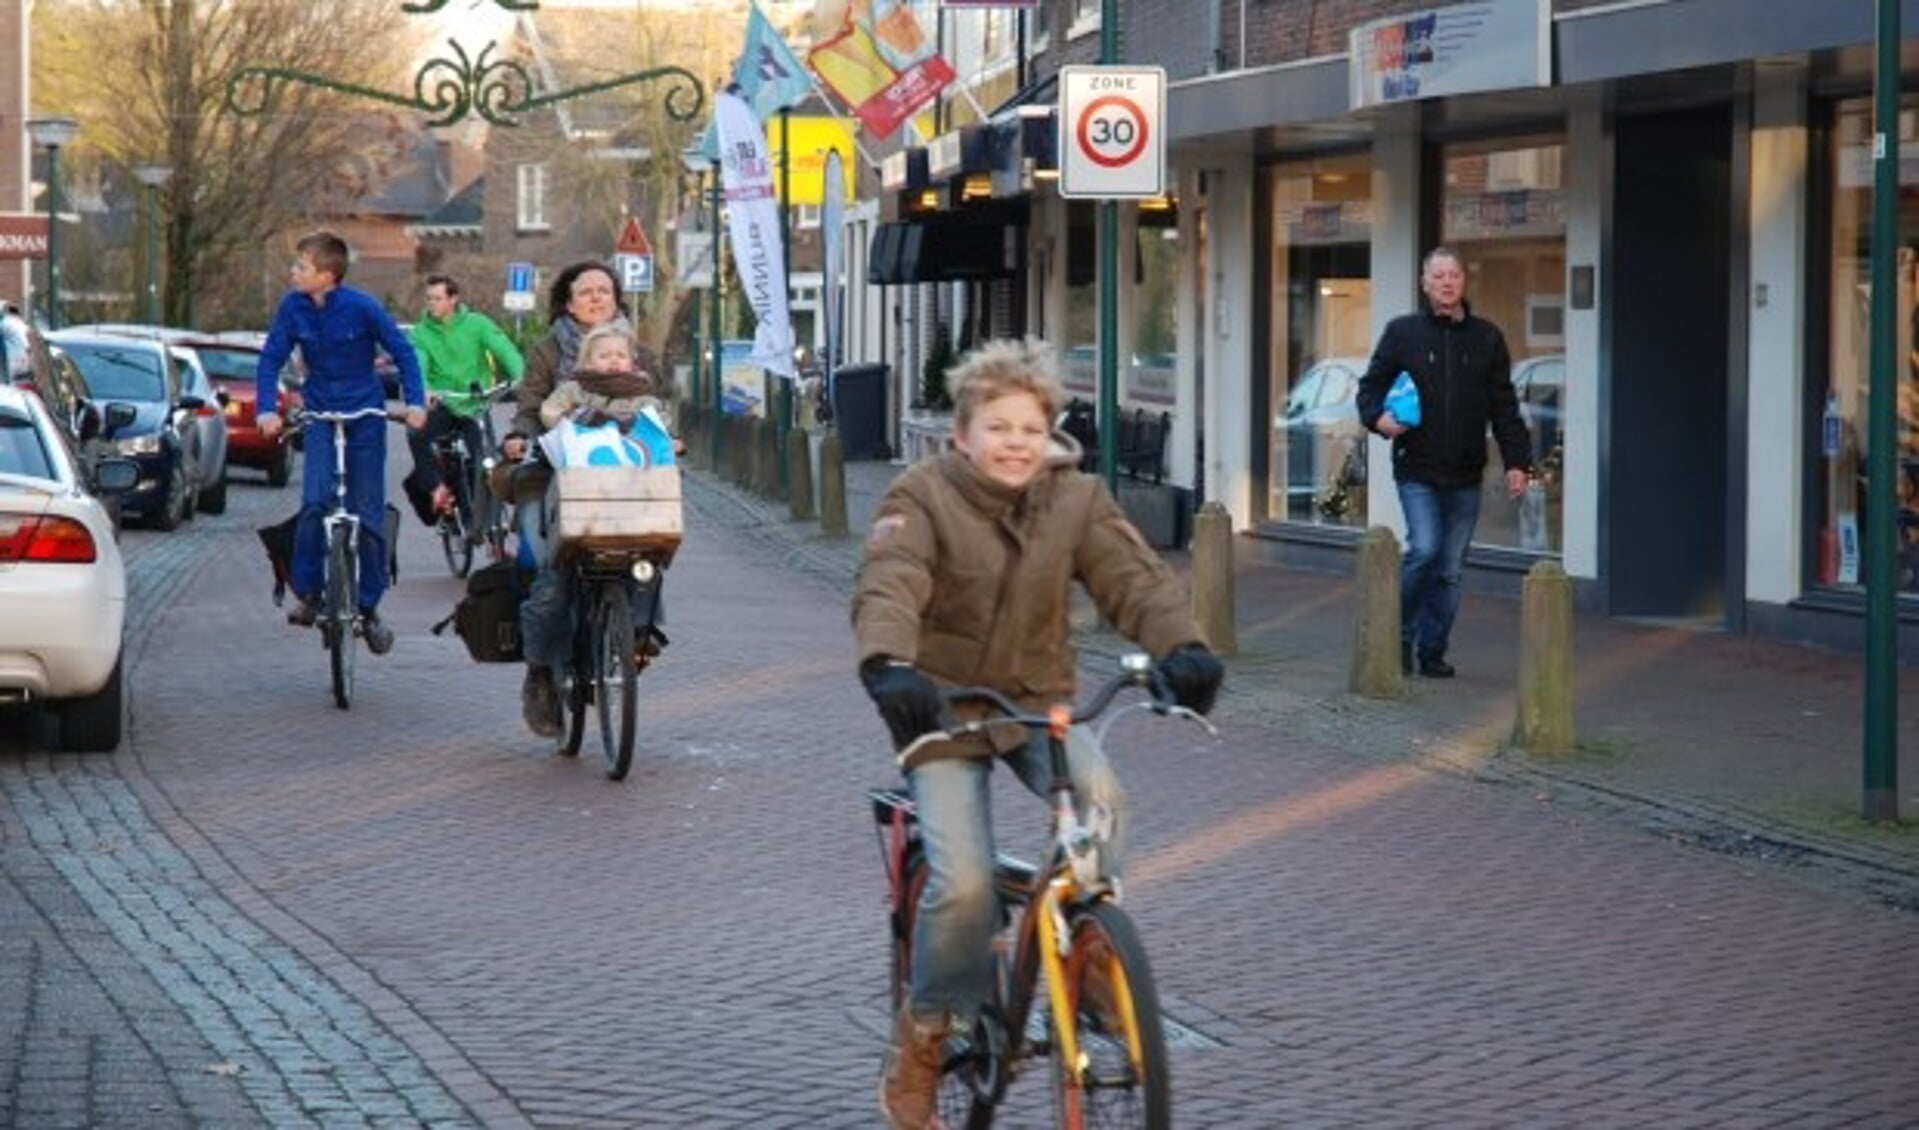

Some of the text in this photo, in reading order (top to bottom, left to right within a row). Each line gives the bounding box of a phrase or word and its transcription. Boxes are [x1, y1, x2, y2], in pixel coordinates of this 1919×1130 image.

[1089, 77, 1137, 90] ZONE
[1092, 117, 1134, 144] 30
[624, 258, 647, 286] P
